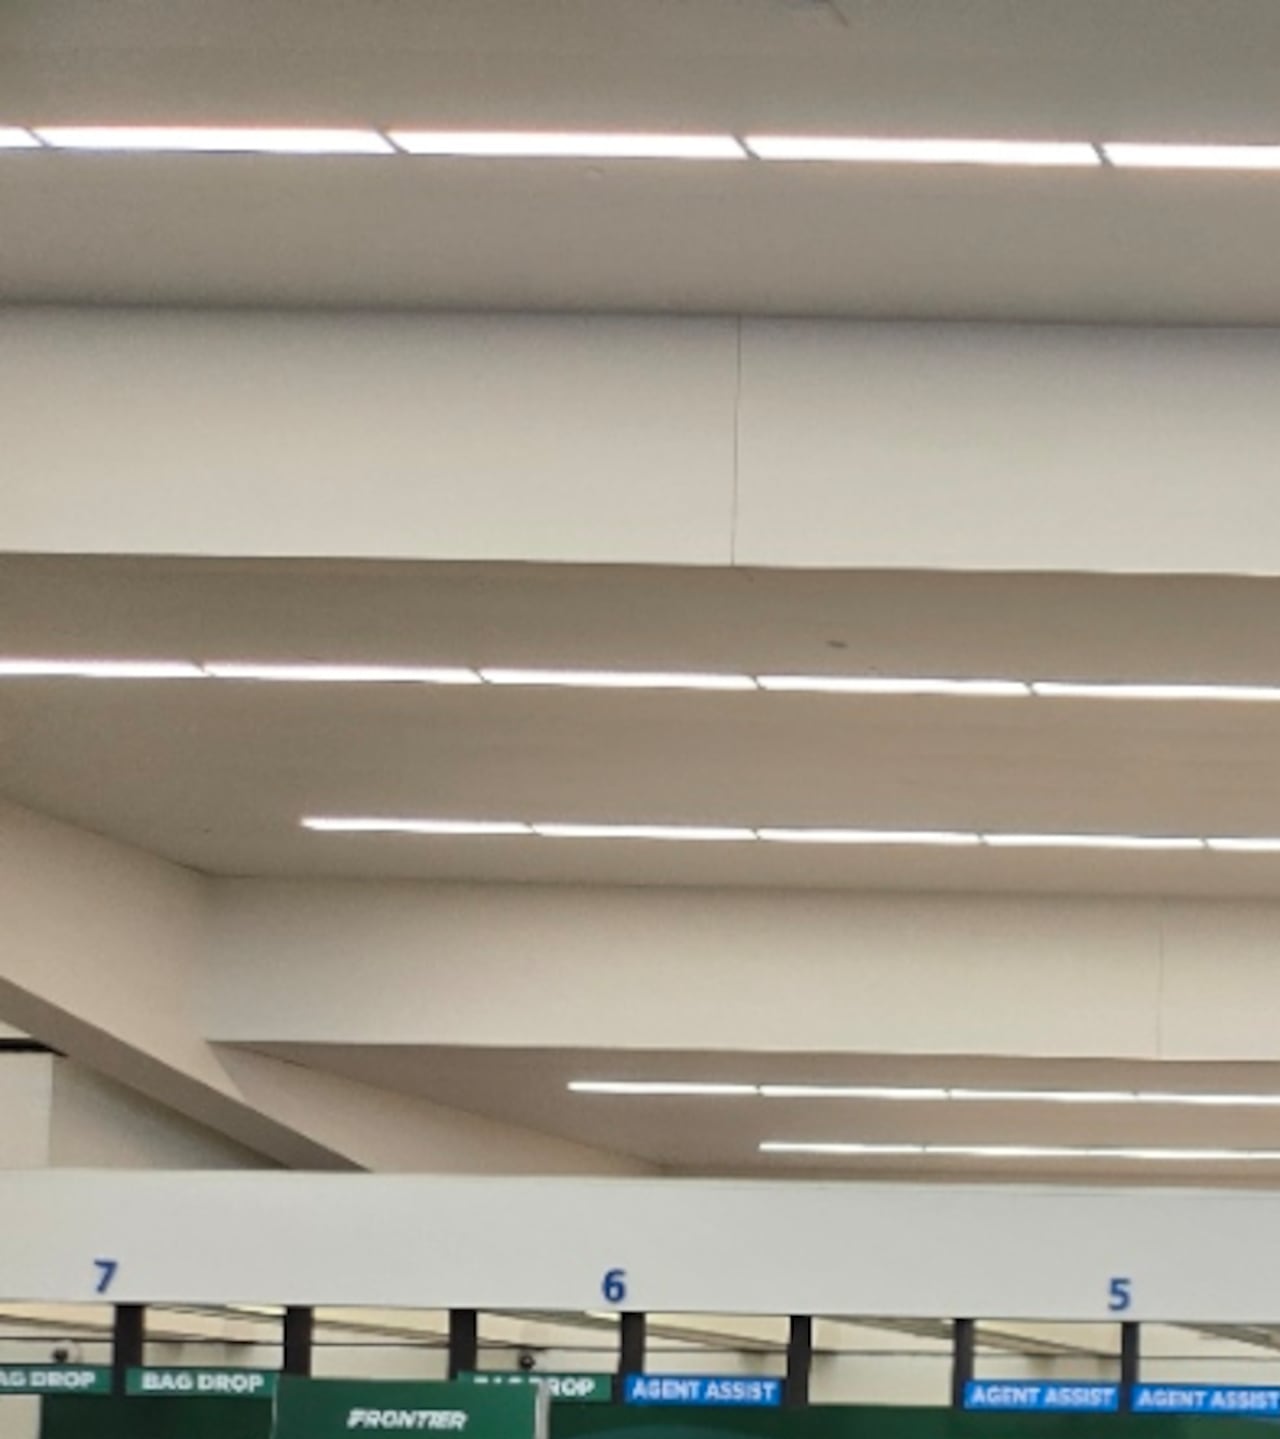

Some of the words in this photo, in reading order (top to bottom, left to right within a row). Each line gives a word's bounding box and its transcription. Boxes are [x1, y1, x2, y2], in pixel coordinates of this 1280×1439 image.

[94, 1260, 117, 1294] 7
[602, 1269, 627, 1302] 6
[1108, 1278, 1131, 1311] 5
[0, 1371, 26, 1387] AG
[31, 1371, 95, 1388] DROP
[142, 1373, 193, 1391] BAG
[197, 1373, 264, 1393] DROP
[632, 1380, 699, 1399] AGENT
[705, 1382, 777, 1401] ASSIST
[970, 1387, 1040, 1404] AGENT
[1045, 1388, 1116, 1406] ASSIST
[1137, 1389, 1206, 1407] AGENT
[1210, 1391, 1280, 1409] ASSIST
[346, 1409, 469, 1431] FRONTIER
